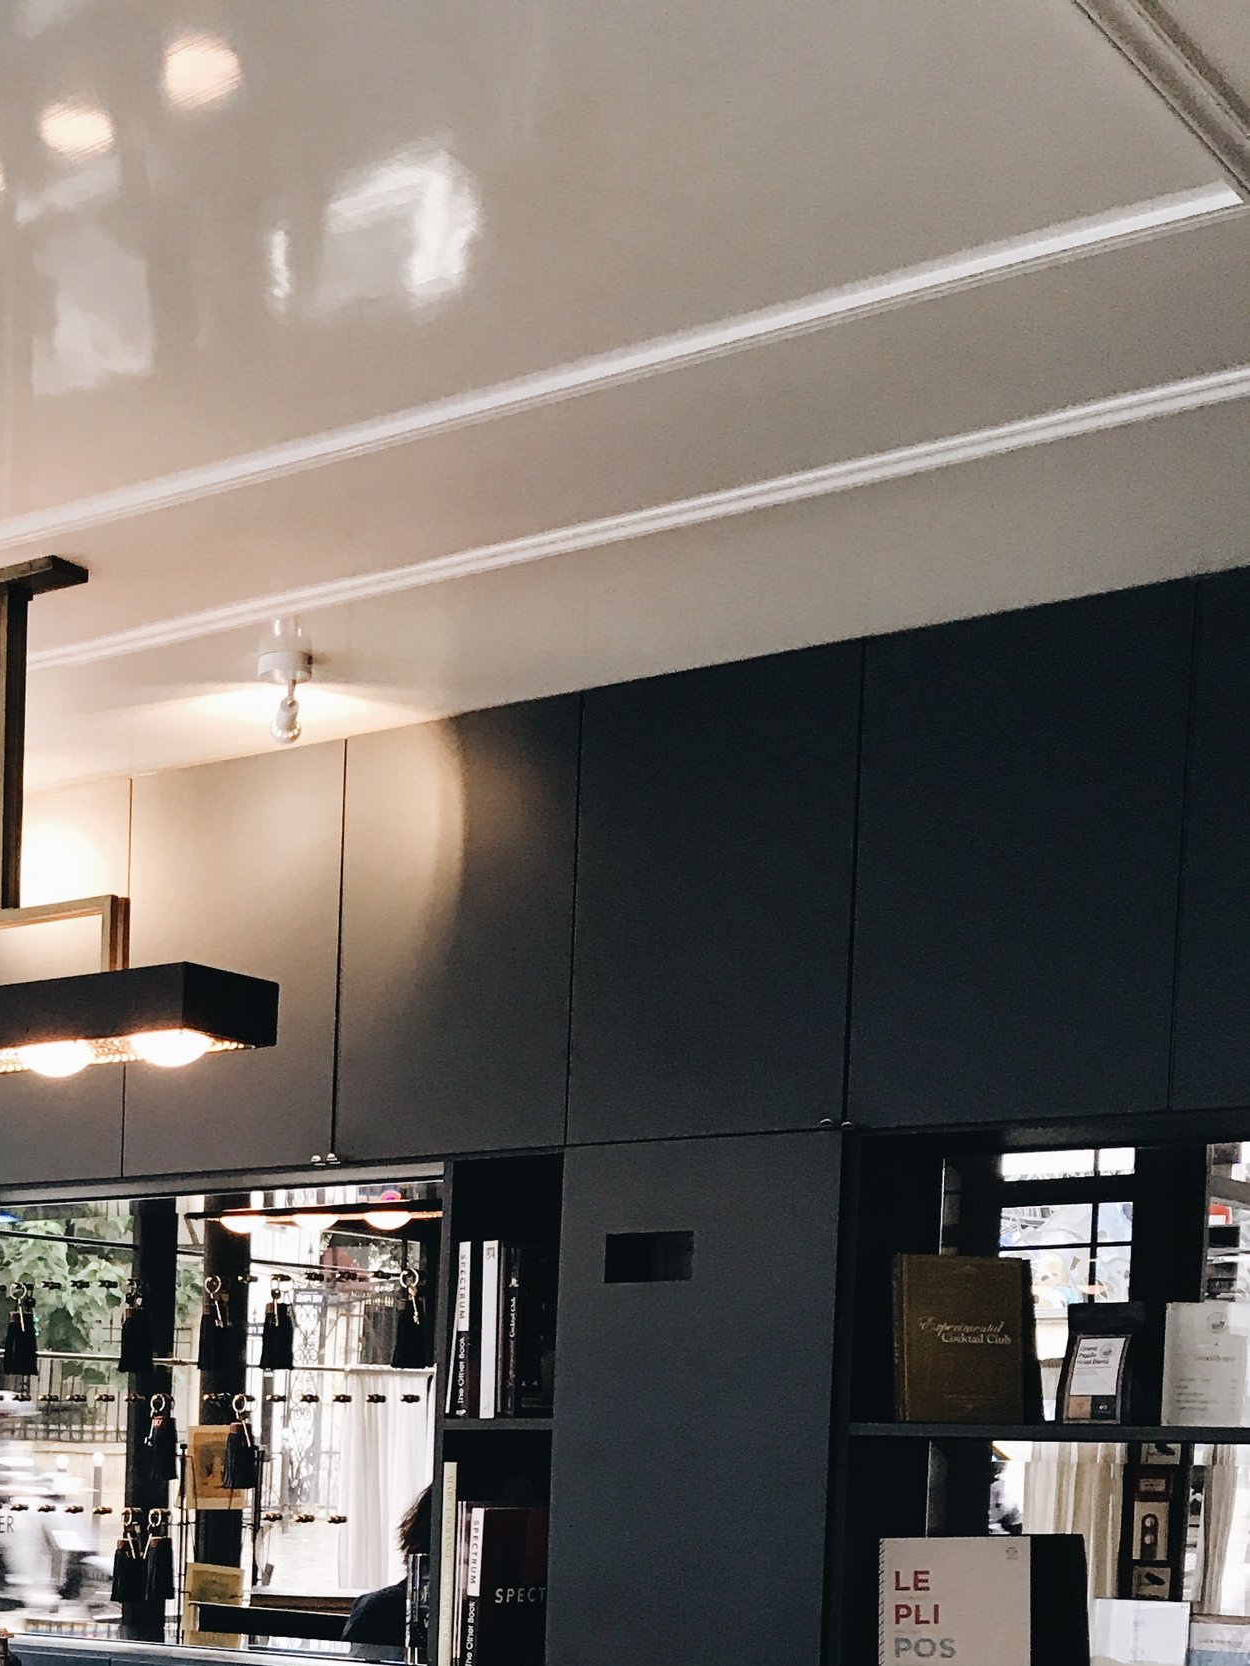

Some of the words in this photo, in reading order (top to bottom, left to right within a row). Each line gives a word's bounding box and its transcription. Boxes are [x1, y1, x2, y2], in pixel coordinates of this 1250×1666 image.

[458, 1253, 467, 1321] SPECTRUM
[458, 1336, 466, 1360] Book
[941, 1333, 984, 1344] Cocktail
[986, 1334, 1012, 1345] Club
[469, 1519, 480, 1585] SPECTRUM
[894, 1570, 930, 1592] LE
[468, 1601, 476, 1624] Book
[894, 1603, 940, 1625] PLI
[465, 1625, 474, 1652] Other
[894, 1637, 956, 1659] POS
